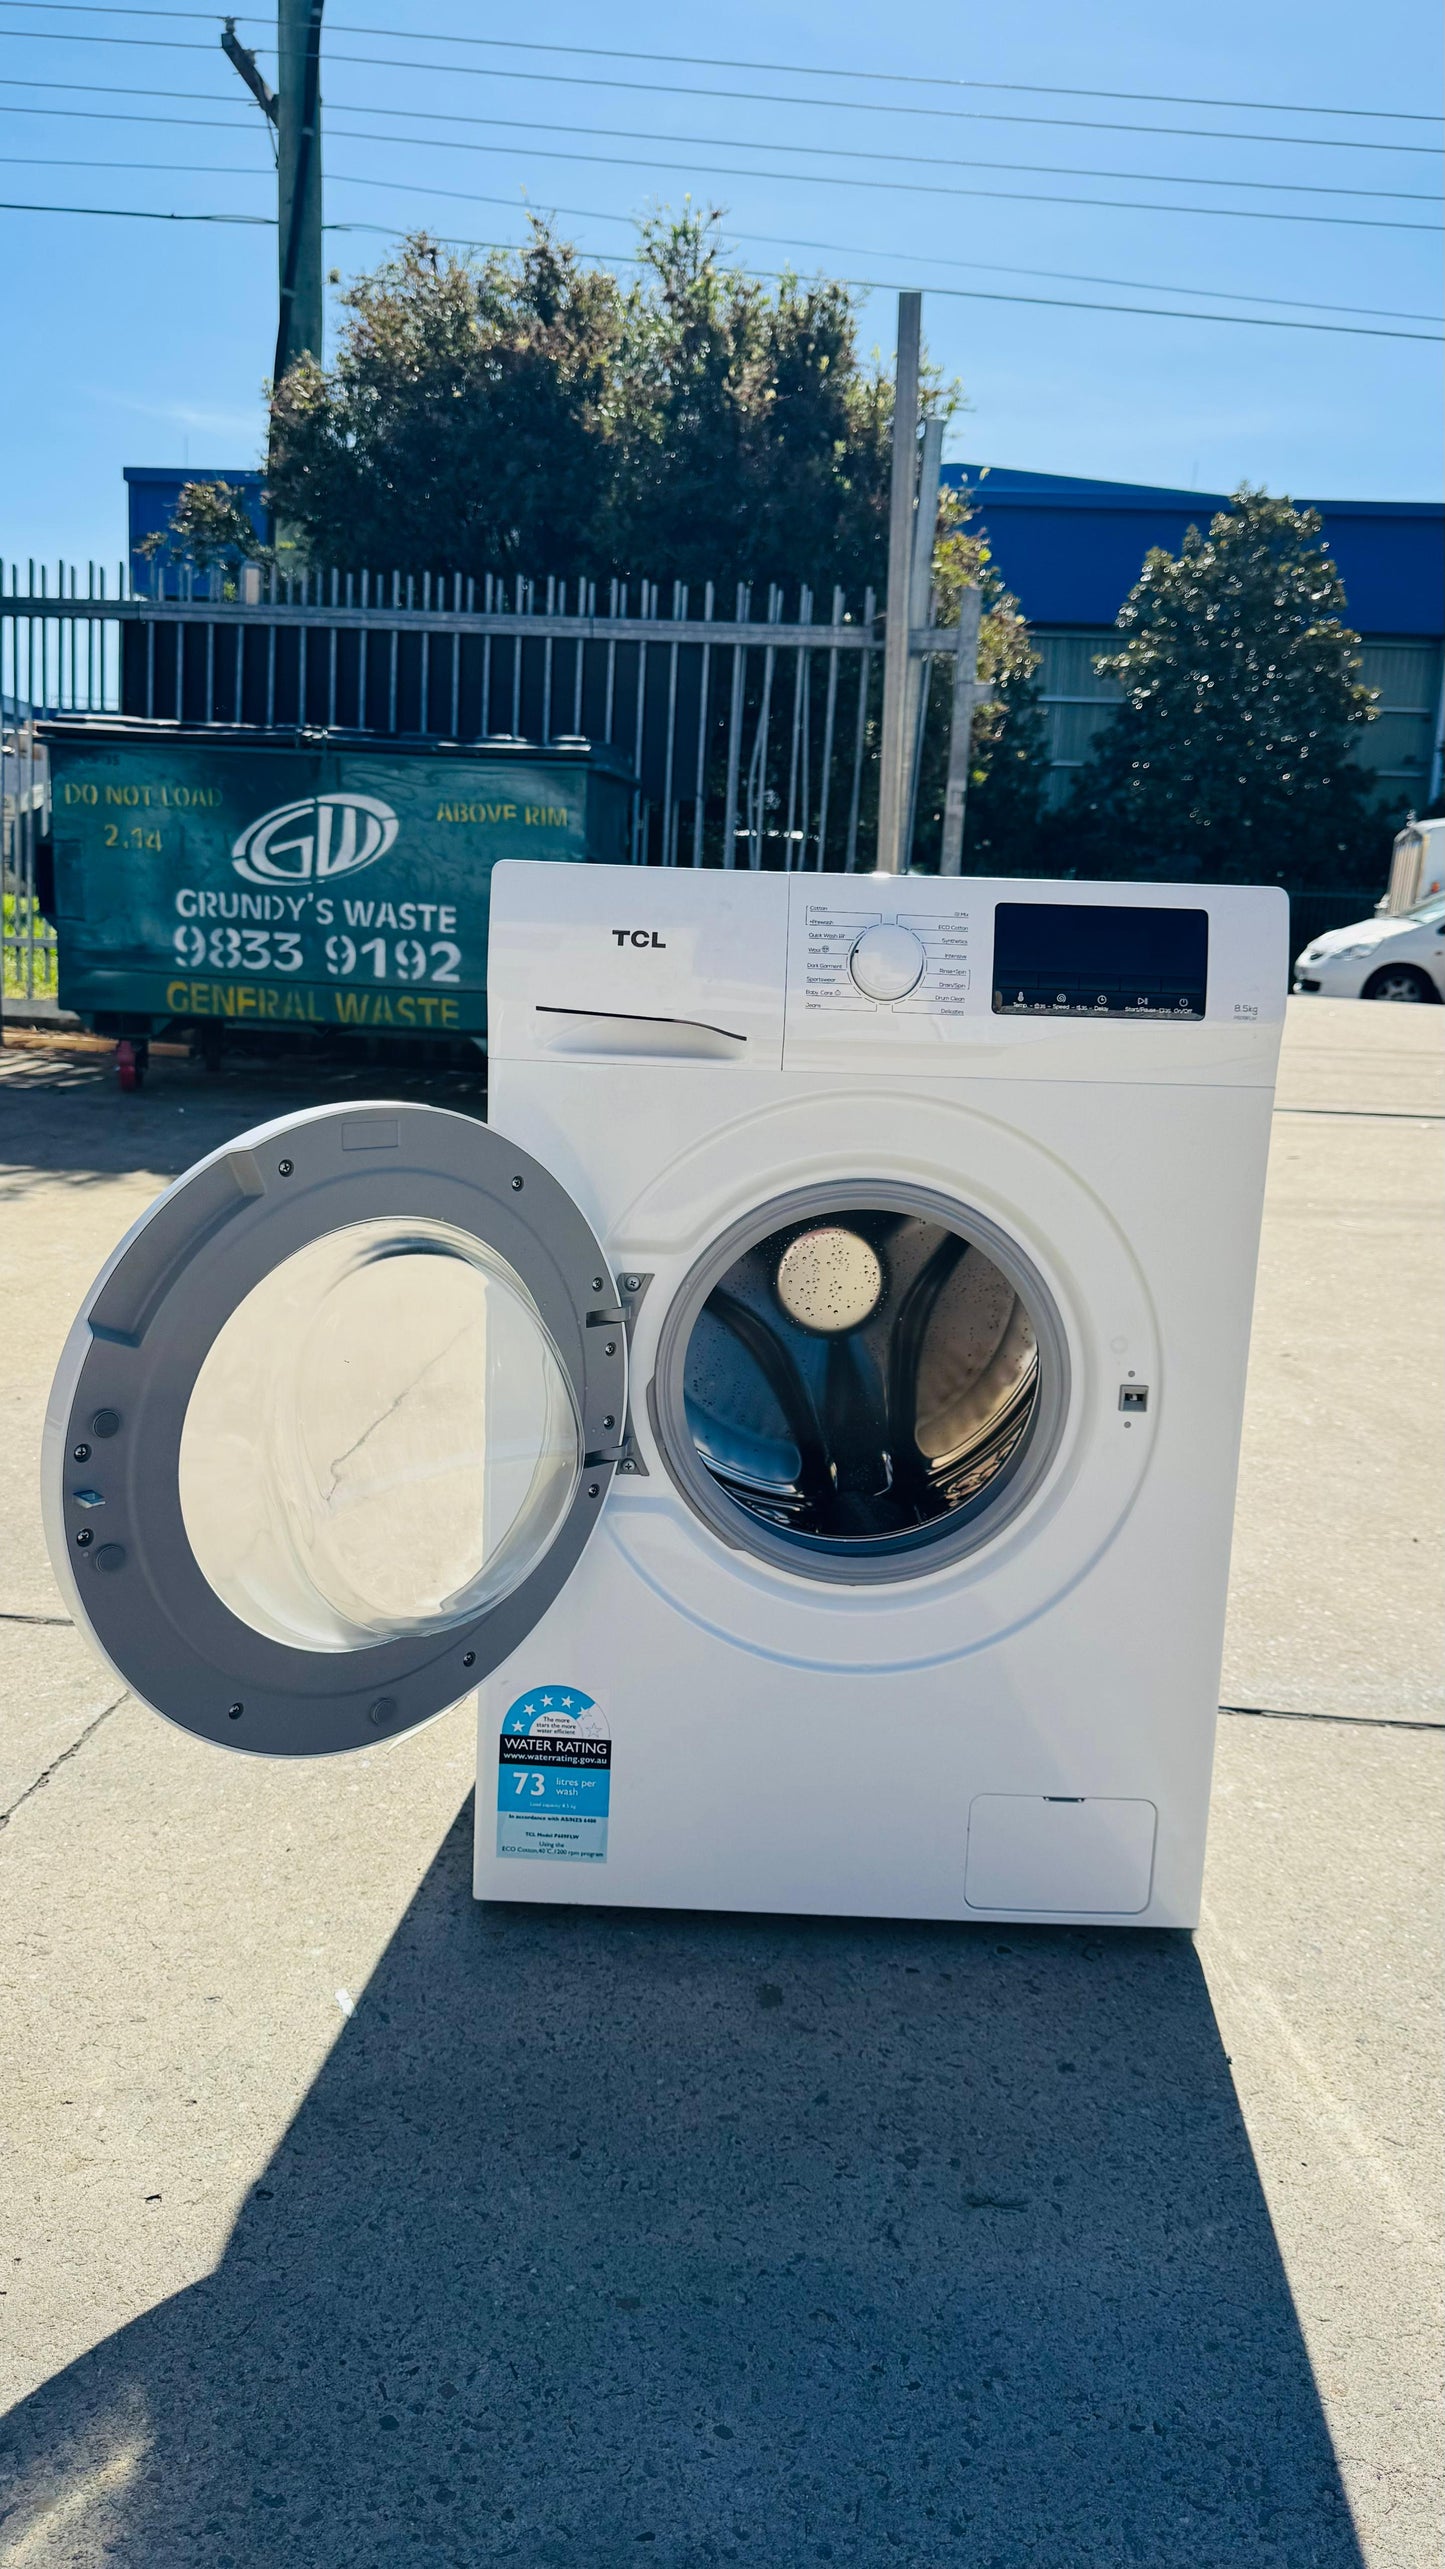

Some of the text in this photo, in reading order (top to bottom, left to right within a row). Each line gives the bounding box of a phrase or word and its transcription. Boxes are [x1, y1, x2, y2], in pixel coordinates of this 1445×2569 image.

[64, 783, 223, 807] DO NOT LOAD
[437, 802, 568, 827] ABOVE RIM
[175, 888, 457, 934] GRUNDY'S WASTE
[612, 929, 666, 948] TCL
[172, 925, 462, 983] 9833 9192
[166, 980, 460, 1030] GENERAL WASTE
[505, 1738, 607, 1754] WATER RATING
[503, 1753, 607, 1765] www.waterrating.gov.au
[512, 1772, 545, 1796] 73
[555, 1788, 579, 1796] wash
[556, 1778, 596, 1789] litres per
[539, 1841, 554, 1849] Using
